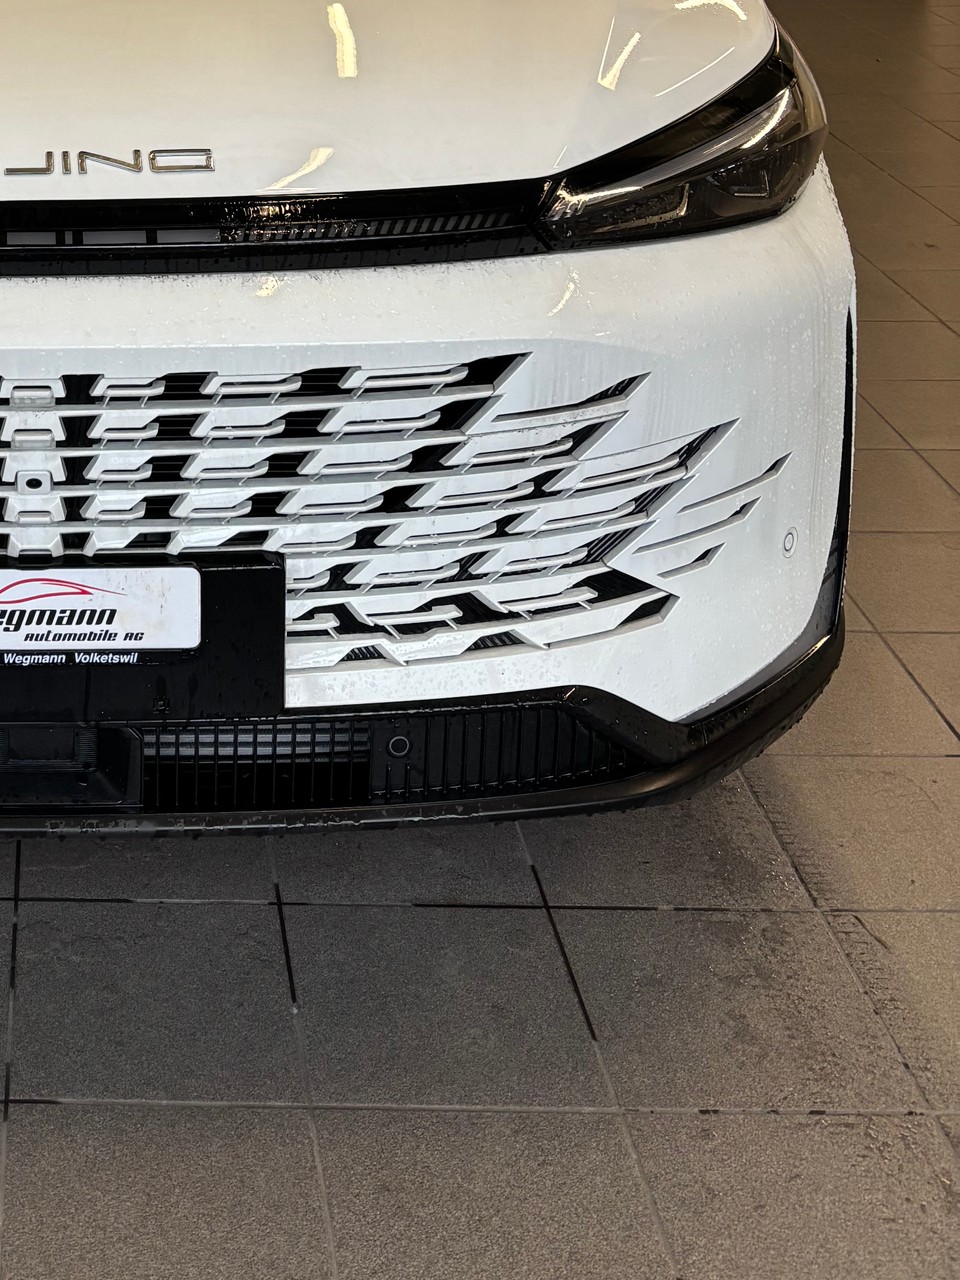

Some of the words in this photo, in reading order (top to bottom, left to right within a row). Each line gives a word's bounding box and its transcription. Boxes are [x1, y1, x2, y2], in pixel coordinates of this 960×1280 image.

[123, 632, 145, 642] AG
[3, 653, 66, 666] Wegmann
[74, 652, 138, 664] Volketswil
